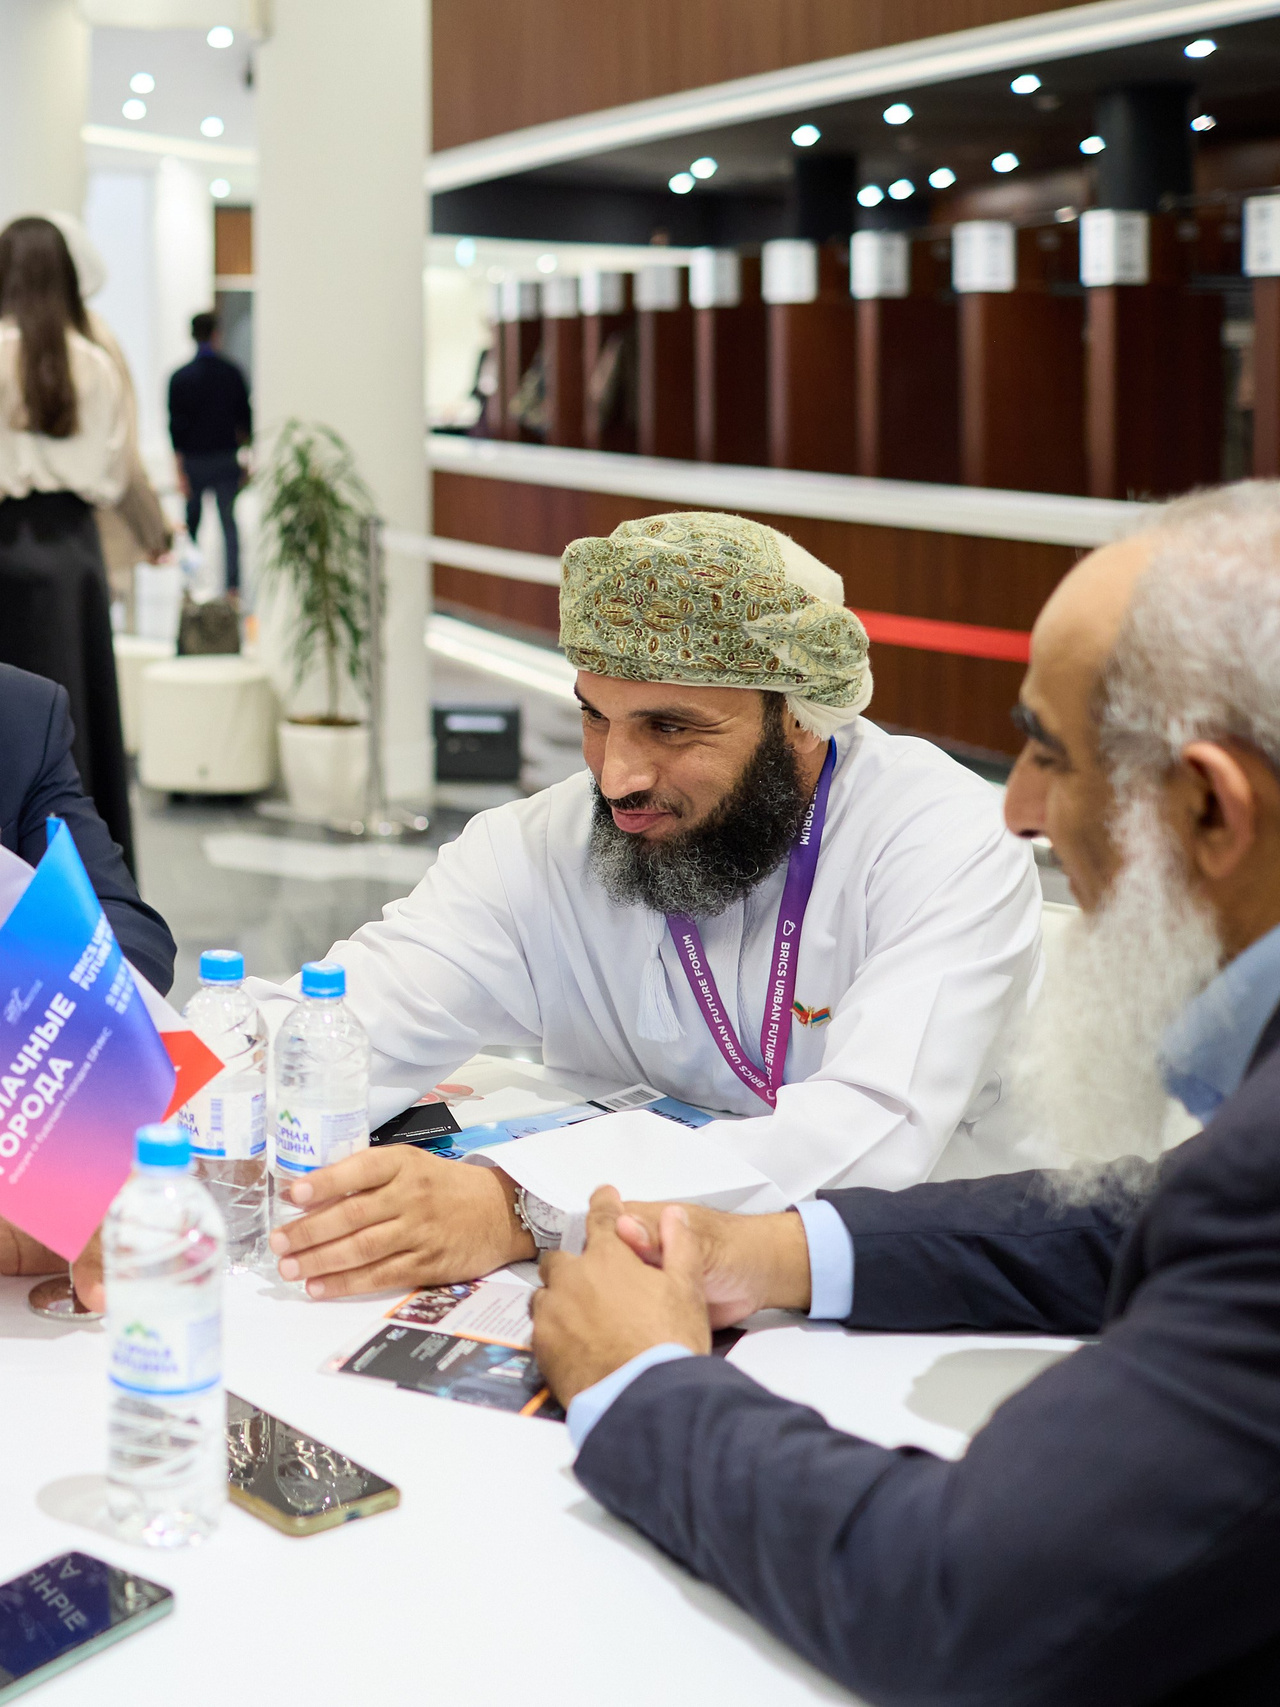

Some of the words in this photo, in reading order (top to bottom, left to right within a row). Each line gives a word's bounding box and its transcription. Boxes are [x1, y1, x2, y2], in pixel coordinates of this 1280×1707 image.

[800, 802, 816, 845] FORUM
[69, 943, 98, 984] BRICS
[79, 940, 112, 991] FUTURE
[682, 934, 703, 976] FORUM
[778, 942, 791, 977] BRICS
[698, 978, 723, 1024] FUTURE
[771, 979, 786, 1022] URBAN
[718, 1026, 741, 1064] URBAN
[764, 1023, 780, 1066] FUTURE
[739, 1065, 766, 1088] BRICS
[275, 1131, 315, 1156] РШИНА
[277, 1123, 310, 1144] РНАЯ
